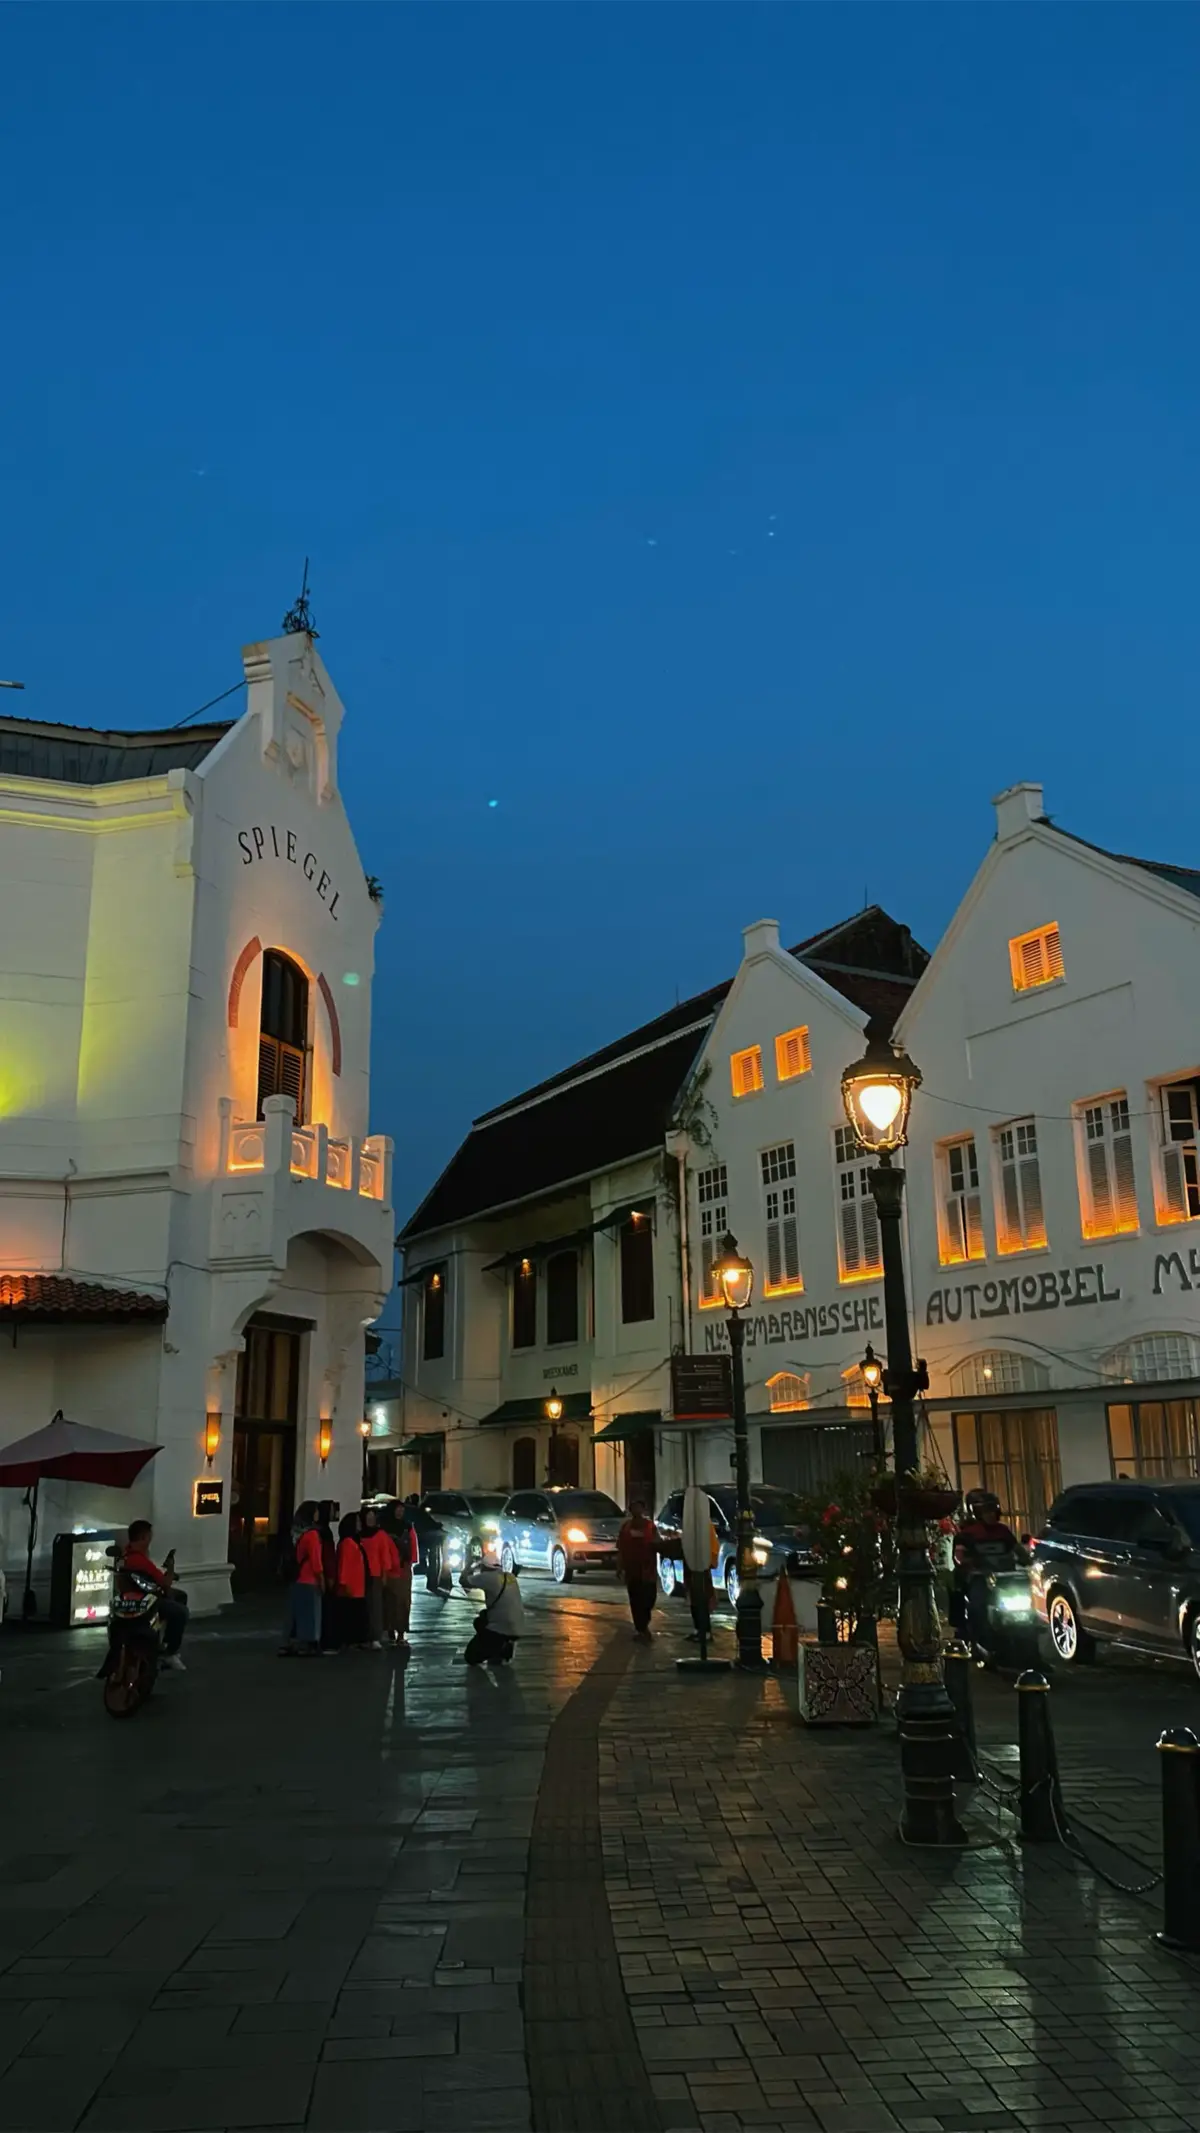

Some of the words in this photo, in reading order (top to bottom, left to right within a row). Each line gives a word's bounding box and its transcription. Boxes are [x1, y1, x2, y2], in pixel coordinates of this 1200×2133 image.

[238, 825, 340, 921] SPIEGEL
[746, 1296, 885, 1346] EMARANGSCHE
[926, 1263, 1121, 1326] AUTOMOBIEL
